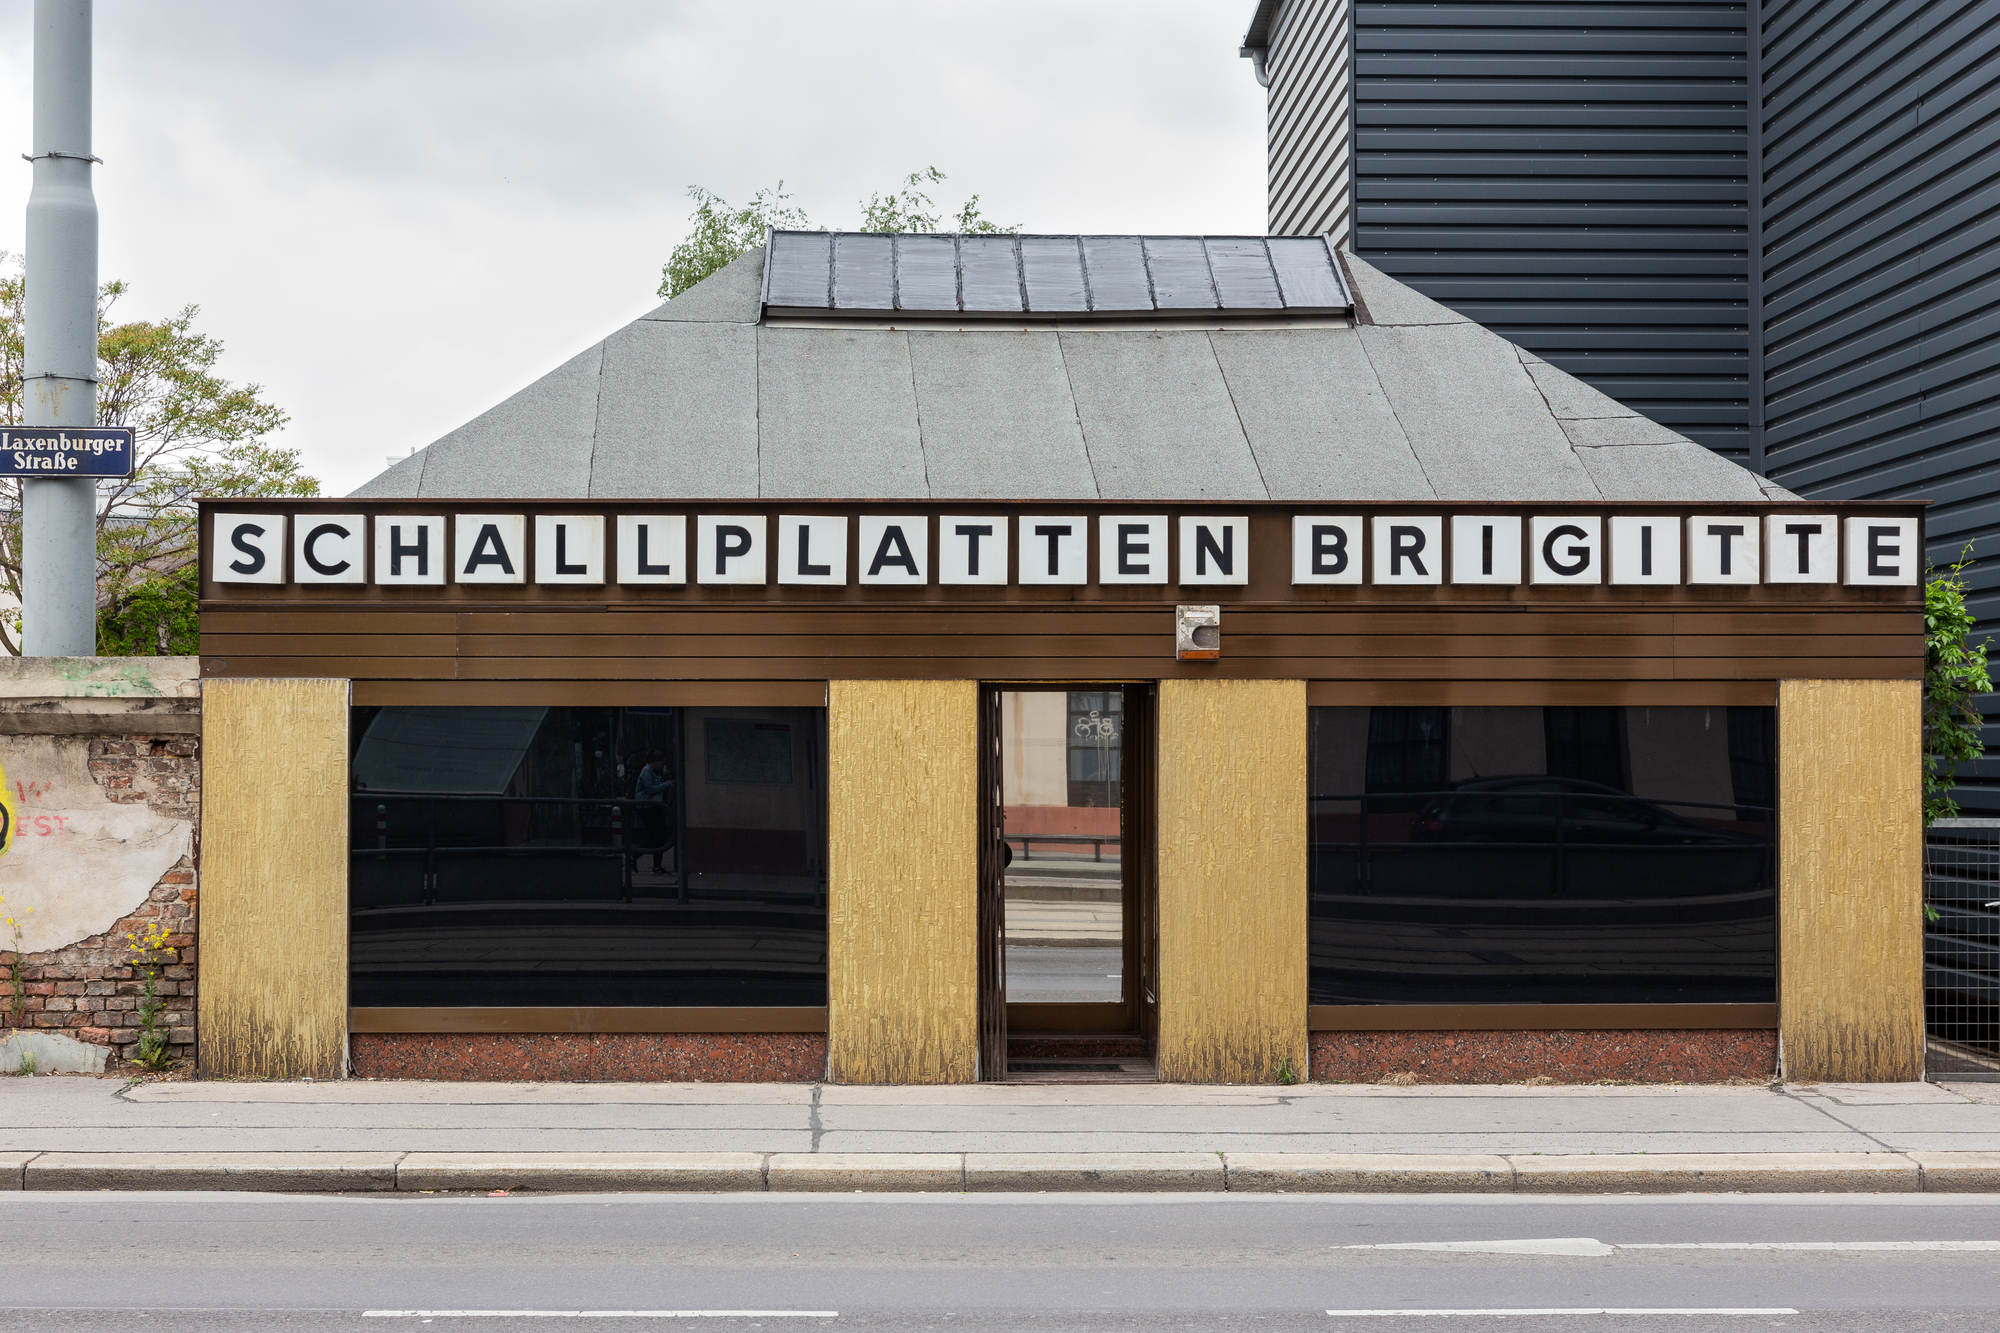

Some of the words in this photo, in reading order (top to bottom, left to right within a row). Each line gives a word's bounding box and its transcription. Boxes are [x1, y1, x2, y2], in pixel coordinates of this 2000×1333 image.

[2, 432, 124, 455] Laxenburger
[14, 452, 78, 469] Straße
[229, 523, 1233, 576] SCHALLPLATTEN
[1311, 524, 1900, 576] BRIGITTE
[1, 815, 69, 836] EST
